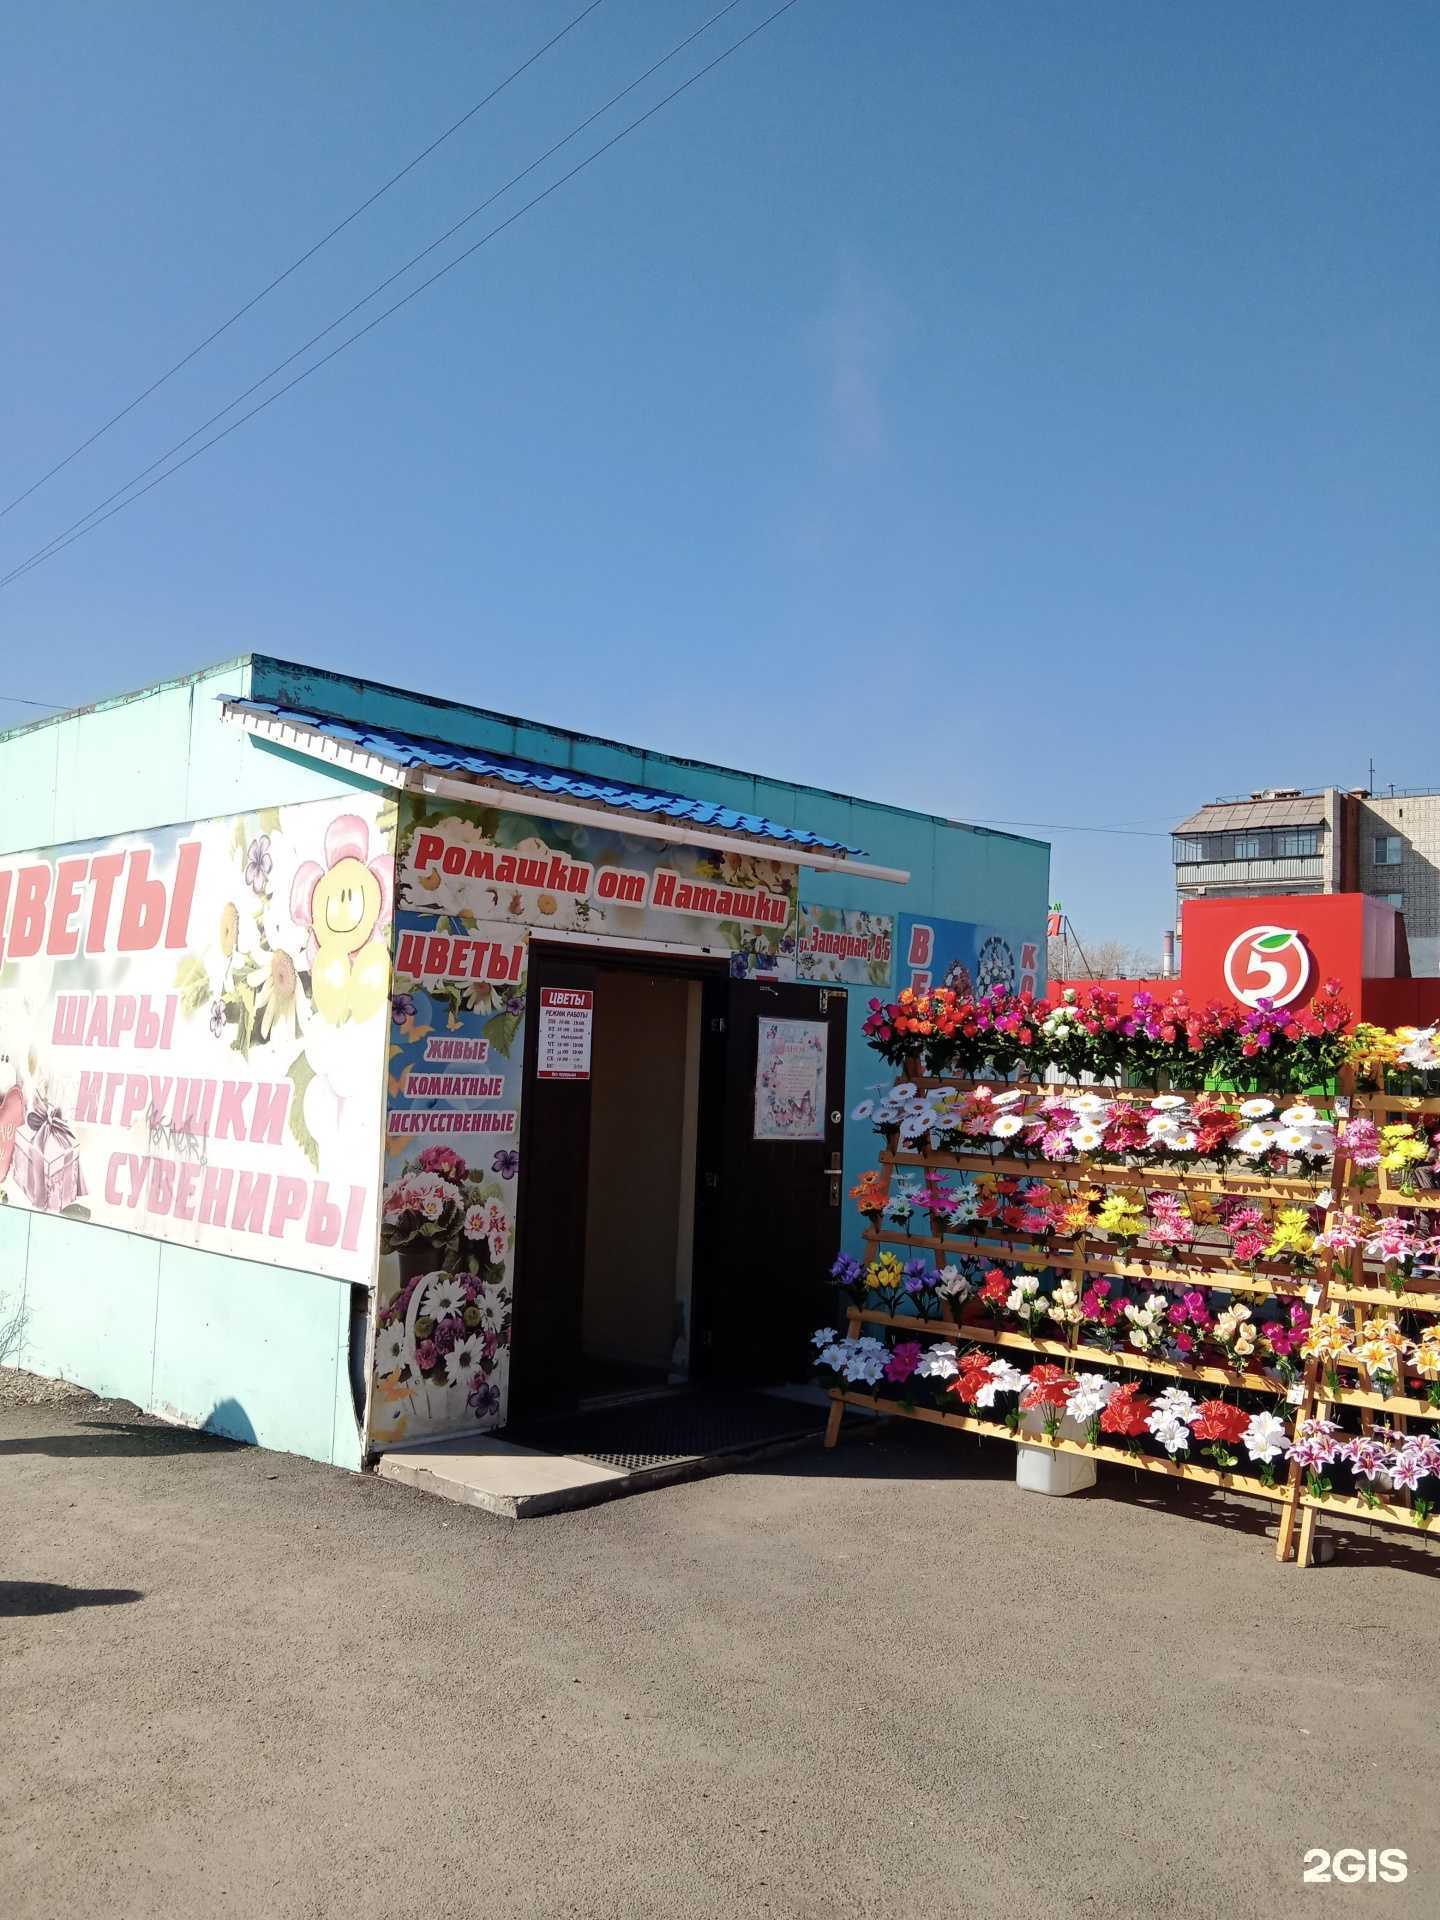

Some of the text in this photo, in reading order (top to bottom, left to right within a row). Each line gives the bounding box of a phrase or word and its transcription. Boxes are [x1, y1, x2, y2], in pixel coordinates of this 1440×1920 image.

[414, 834, 789, 925] Ромашки от Наташки
[396, 937, 524, 981] ЦВЕТЫ
[548, 991, 585, 1006] ЦВЕТЫ
[566, 1011, 588, 1019] РАБОТЫ
[52, 994, 178, 1050] ШАРЫ
[427, 1038, 487, 1062] ЖИВЫЕ
[406, 1074, 502, 1097] КОМНАТНЫЕ
[75, 1070, 291, 1146] ИГРУШКИ
[388, 1112, 515, 1134] ИСКУССТВЕННЫЕ
[105, 1151, 367, 1252] СУВЕНИРЫ
